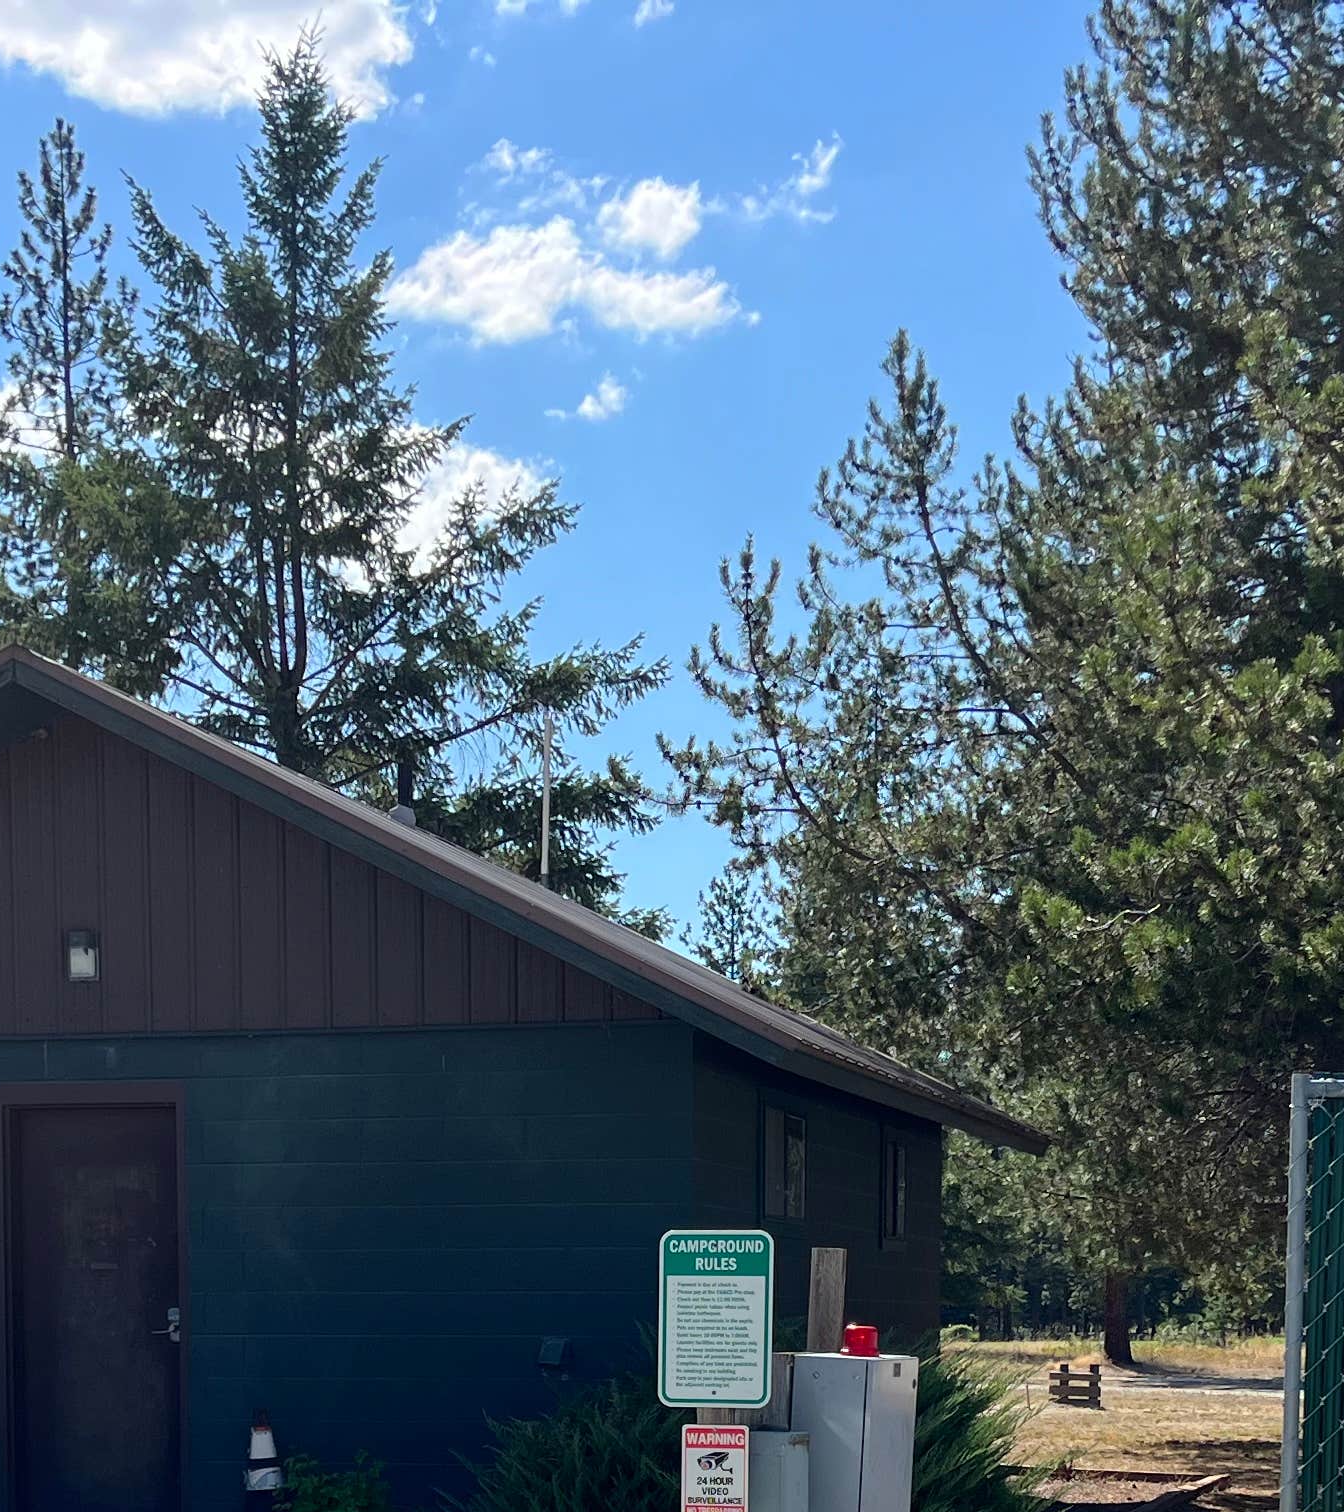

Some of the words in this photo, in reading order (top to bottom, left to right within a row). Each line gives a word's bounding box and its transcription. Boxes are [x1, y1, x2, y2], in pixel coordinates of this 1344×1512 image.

[669, 1239, 765, 1254] CAMPGROUND
[695, 1257, 737, 1271] RULES
[687, 1432, 745, 1446] WARNING
[696, 1477, 707, 1485] 24
[709, 1477, 733, 1486] HOUR
[702, 1488, 729, 1496] VIDEO
[688, 1497, 743, 1505] SURVEILLANCE
